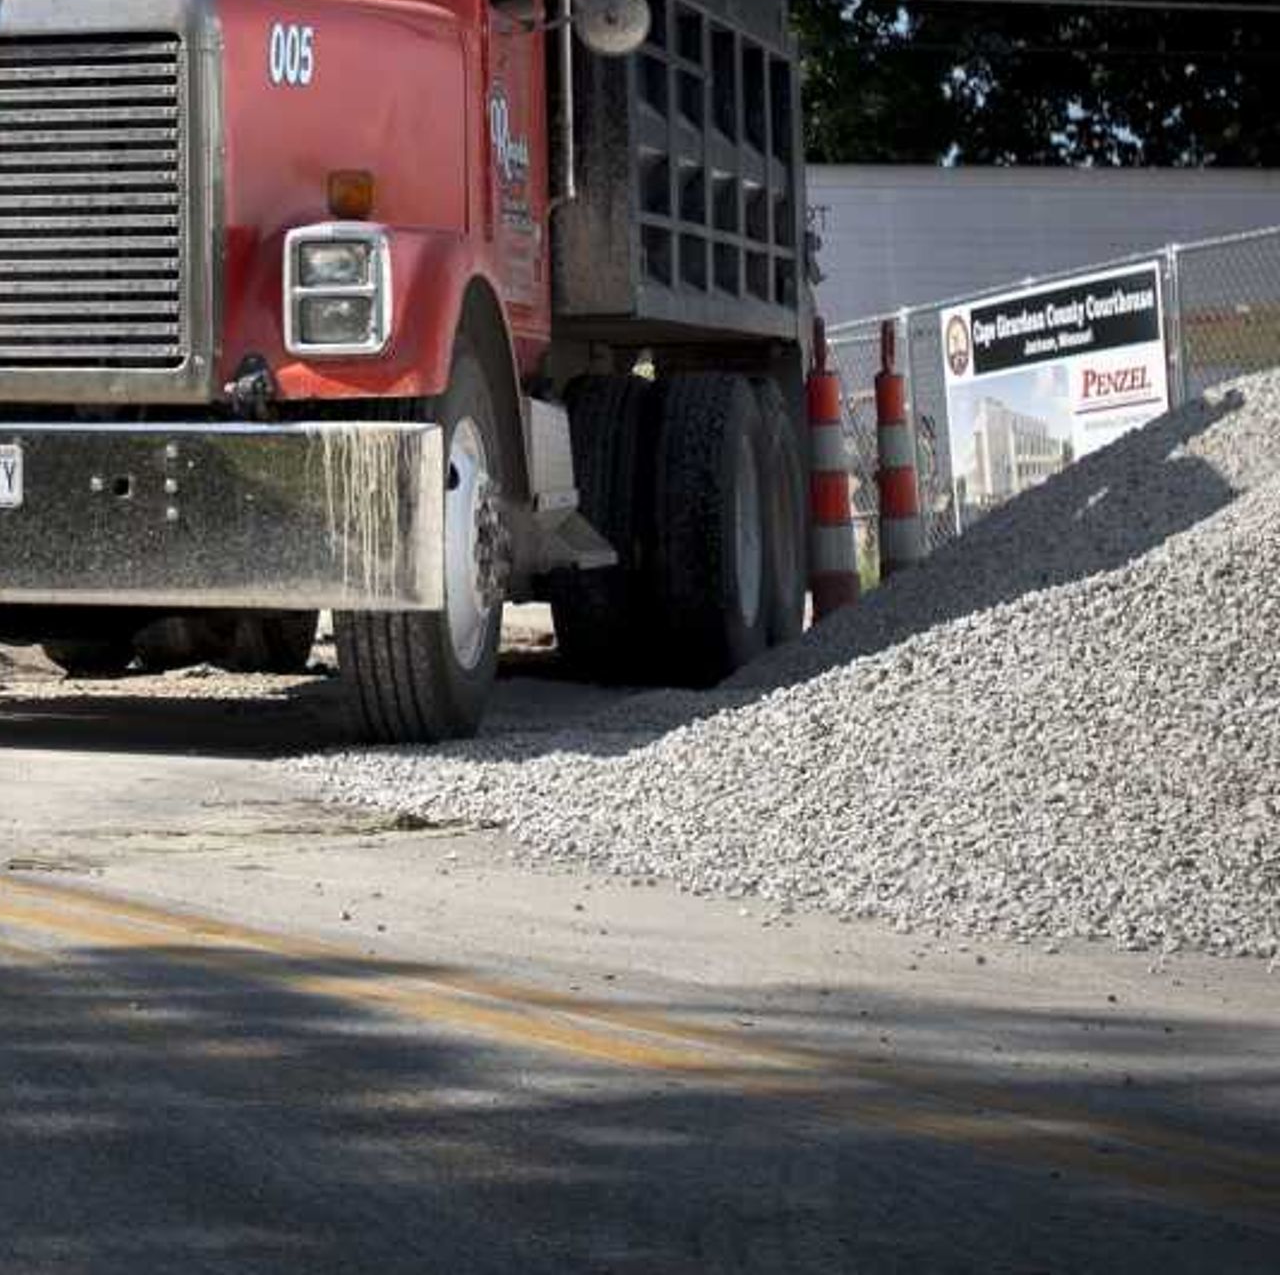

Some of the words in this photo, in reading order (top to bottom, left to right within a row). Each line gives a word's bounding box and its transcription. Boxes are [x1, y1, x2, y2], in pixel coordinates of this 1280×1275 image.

[269, 21, 314, 85] 005
[1046, 301, 1085, 328] County
[1085, 289, 1155, 321] Courthouse
[1082, 365, 1152, 398] PENZEL
